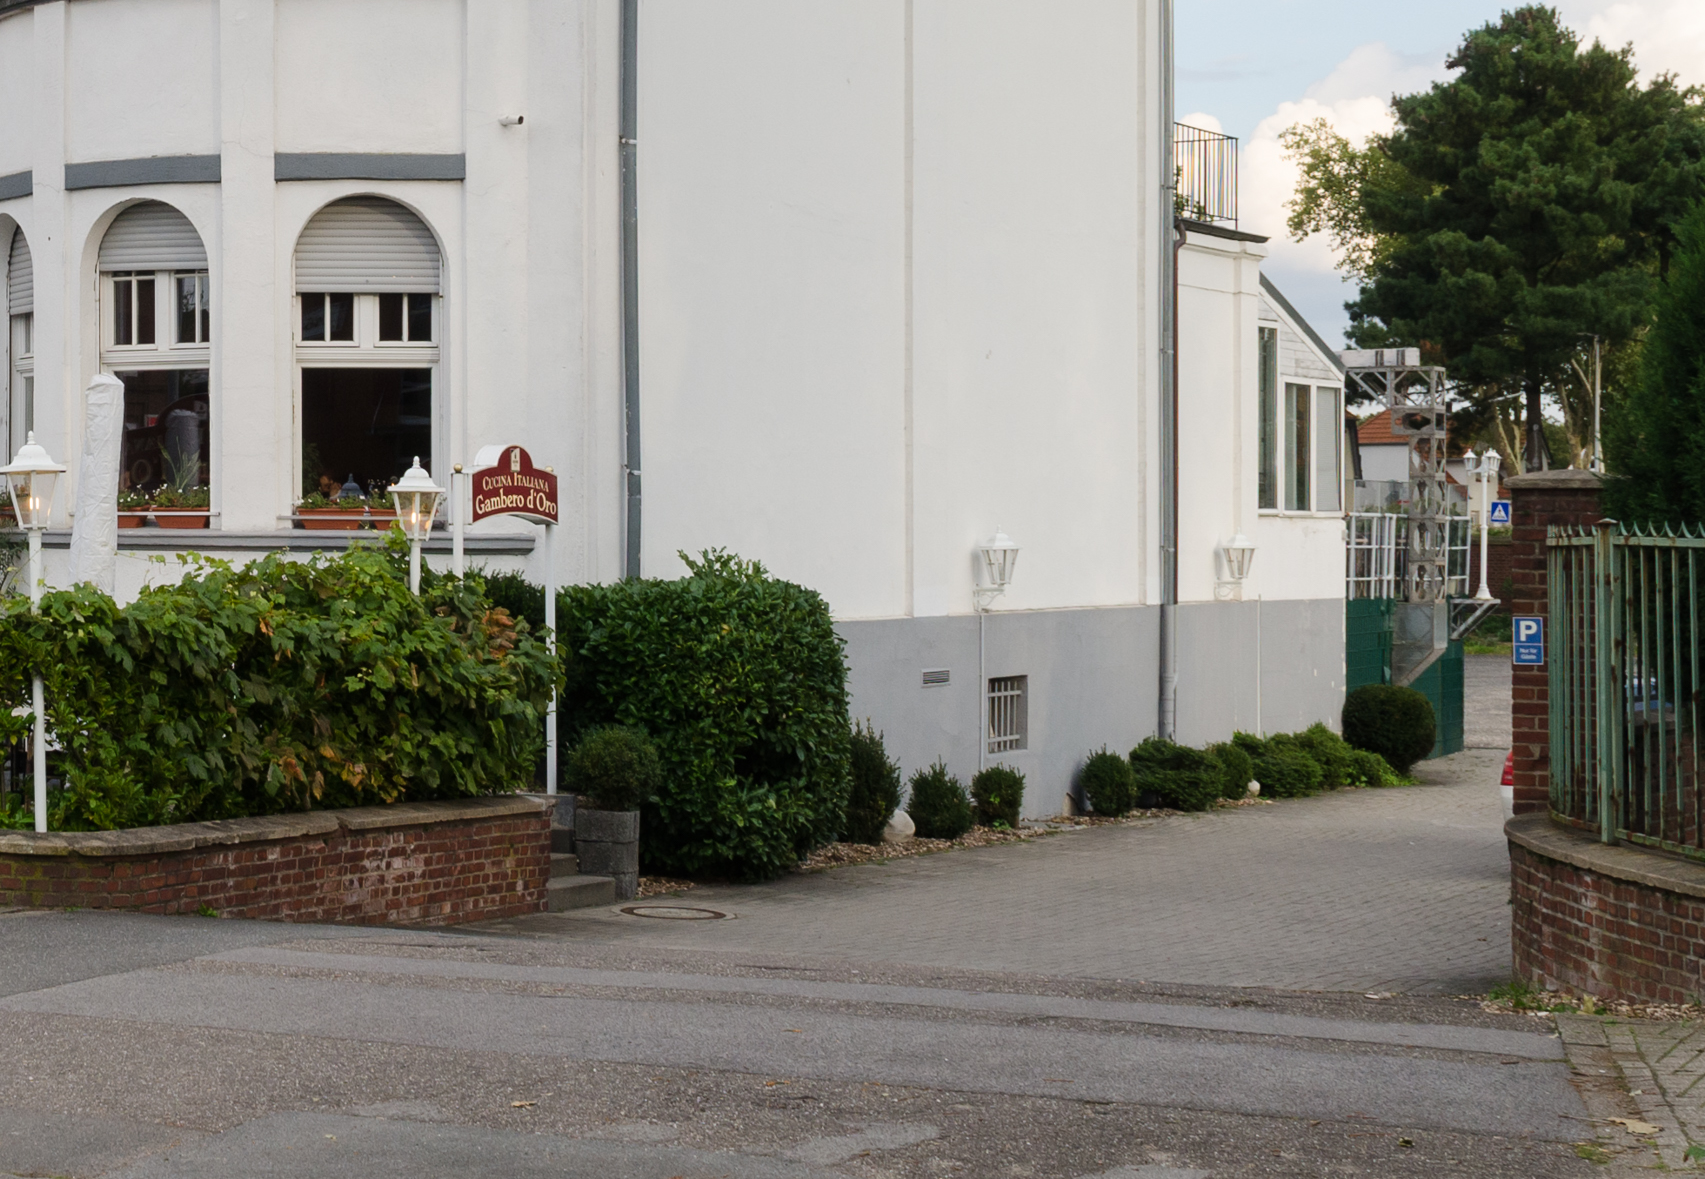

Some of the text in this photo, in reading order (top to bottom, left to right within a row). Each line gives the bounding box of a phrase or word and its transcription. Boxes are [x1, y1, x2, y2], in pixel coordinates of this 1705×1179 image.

[482, 472, 549, 493] CUCINA ITALIANA
[476, 488, 525, 515] Gambero
[1519, 620, 1538, 642] P
